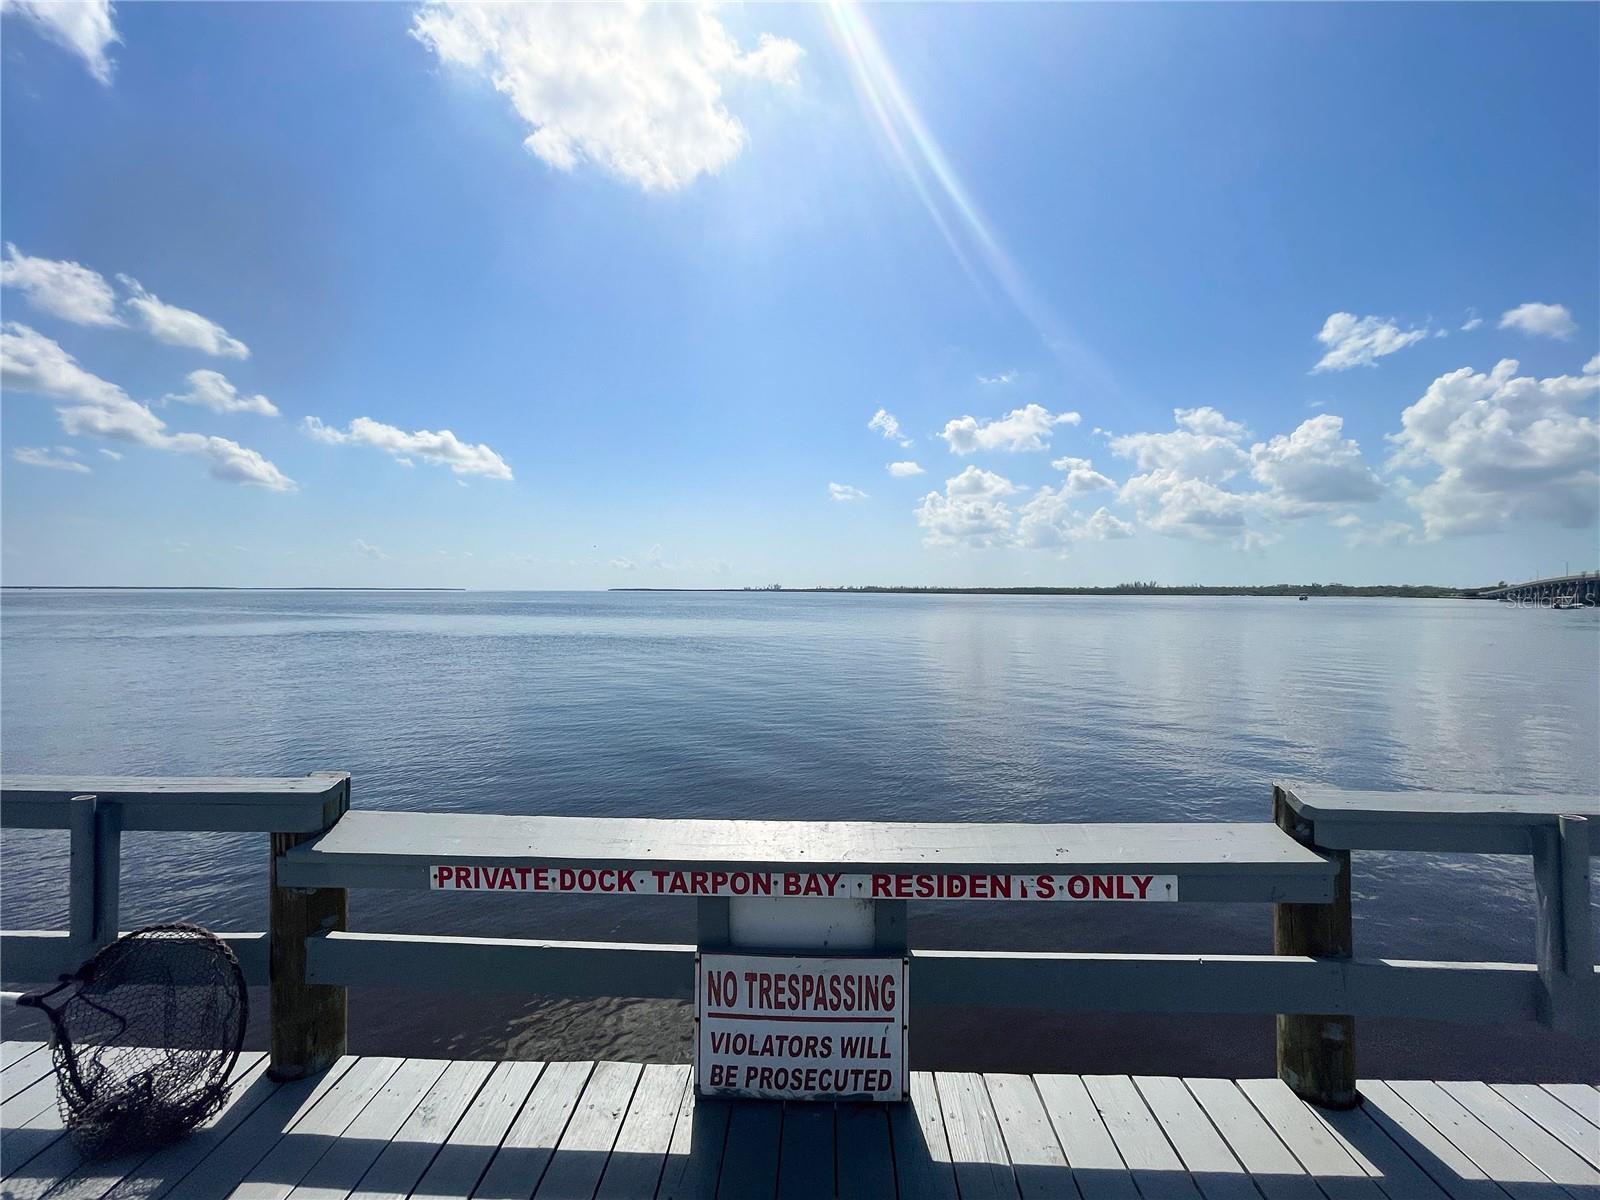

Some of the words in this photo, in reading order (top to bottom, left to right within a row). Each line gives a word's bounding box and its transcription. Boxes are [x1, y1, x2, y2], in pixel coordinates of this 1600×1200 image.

[437, 866, 549, 891] PRIVATE
[559, 869, 637, 892] DOCK
[652, 870, 772, 896] TARPON
[783, 872, 842, 896] BAY
[1067, 875, 1154, 899] ONLY
[707, 970, 738, 1008] NO
[744, 972, 896, 1012] TRESPASSING
[710, 1031, 833, 1058] VIOLATORS
[840, 1036, 892, 1059] WILL
[709, 1064, 739, 1087] BE
[744, 1066, 892, 1092] PROSECUTED
